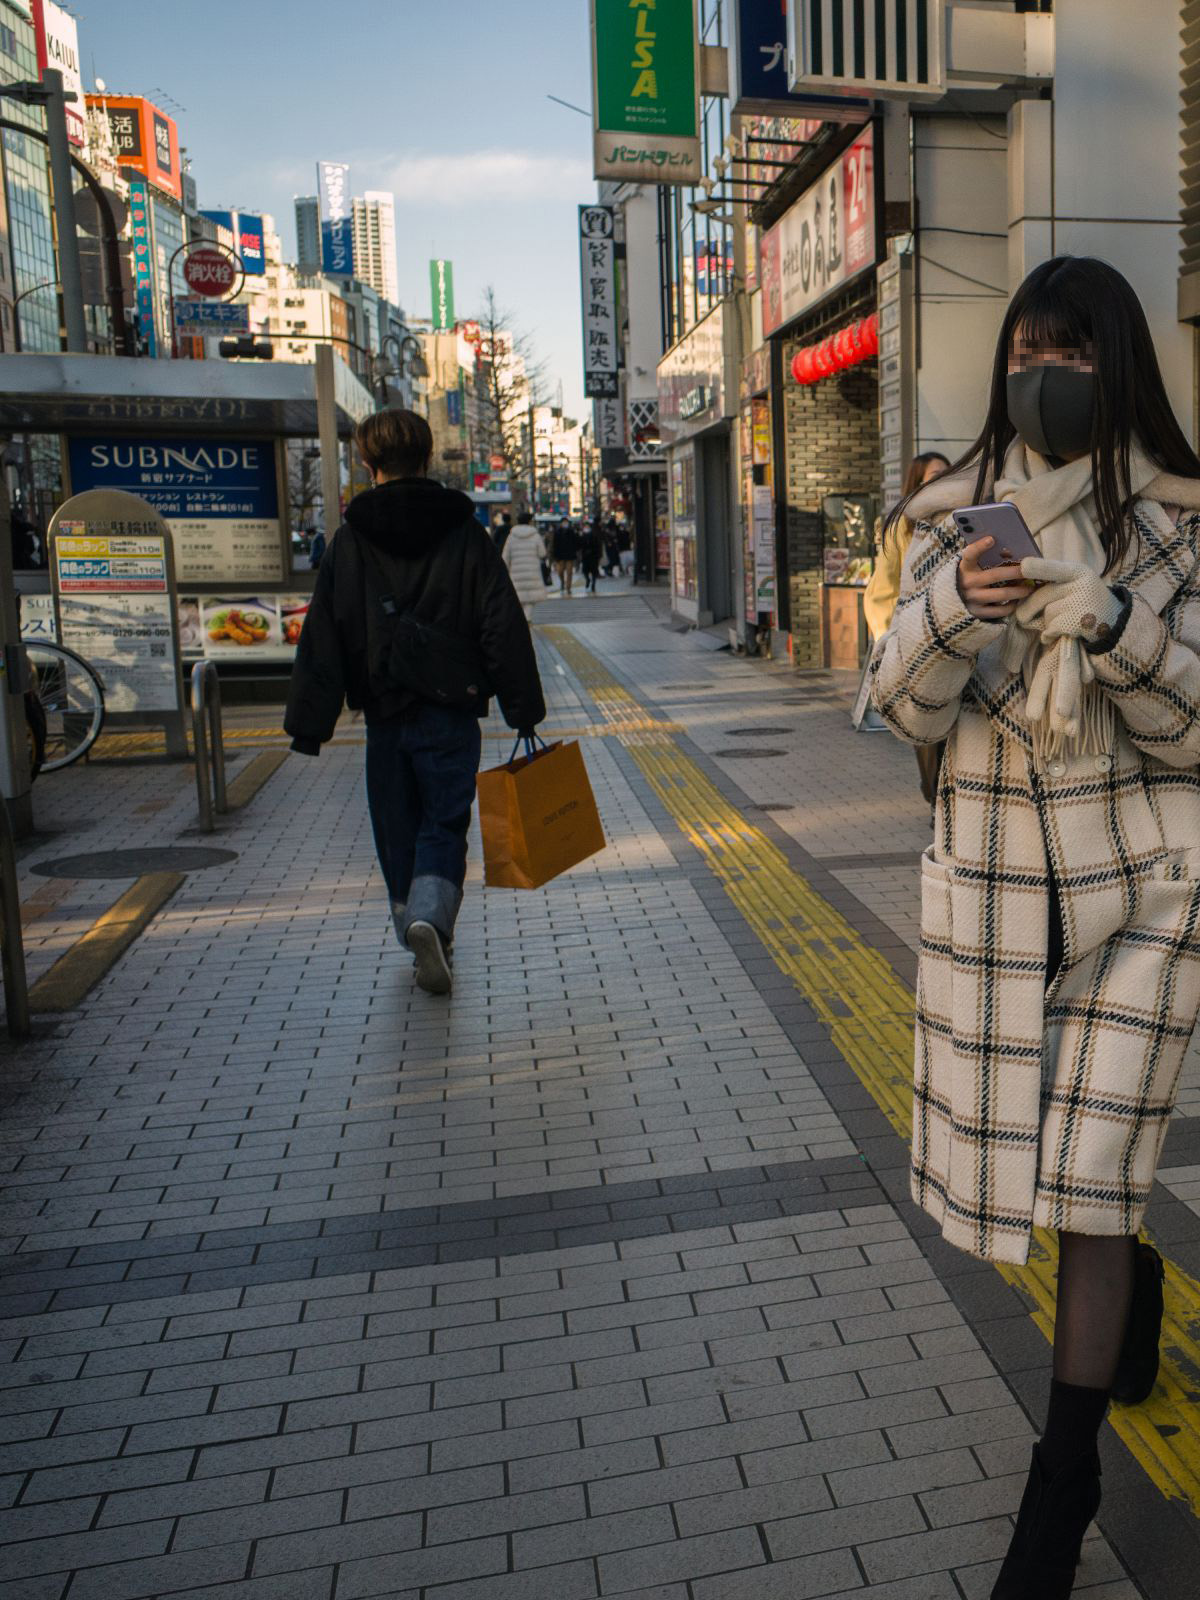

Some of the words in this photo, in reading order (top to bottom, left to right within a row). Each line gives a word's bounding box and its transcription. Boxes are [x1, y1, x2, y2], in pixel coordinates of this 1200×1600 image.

[47, 33, 78, 74] KAIUL
[760, 41, 788, 72] プ
[604, 145, 694, 167] パンドラビル
[849, 147, 867, 225] 24
[187, 262, 232, 284] 消火栓
[90, 445, 260, 473] SUBNADE
[186, 492, 225, 502] レストラン
